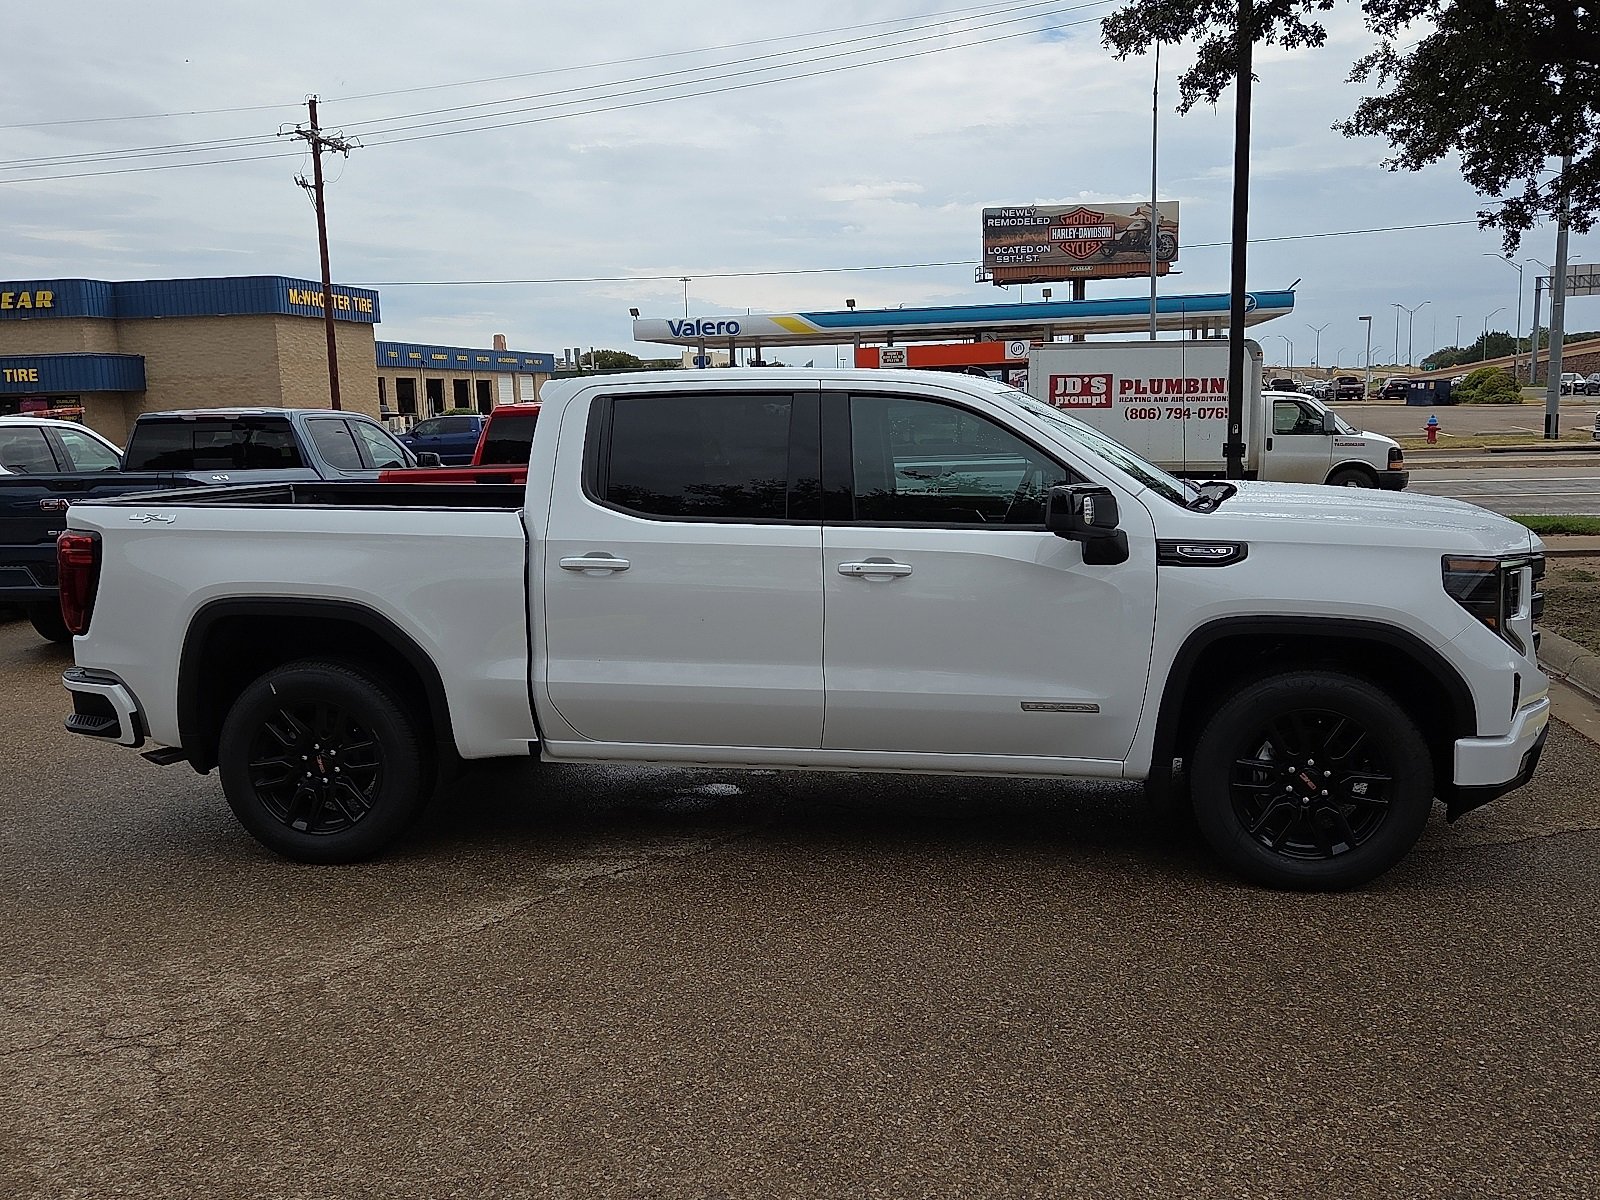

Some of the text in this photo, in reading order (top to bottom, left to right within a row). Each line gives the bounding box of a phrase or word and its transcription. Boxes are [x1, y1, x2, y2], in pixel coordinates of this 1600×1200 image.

[1001, 208, 1036, 217] NEWLY
[1066, 212, 1098, 225] MOTOR
[987, 217, 1050, 226] REMODELED
[1051, 226, 1112, 240] HARLEY-DAVIDSON
[988, 245, 1051, 255] LOCATED ON
[1065, 241, 1097, 256] CYCLES
[1025, 254, 1041, 262] ST.
[288, 288, 373, 313] McWHOTER TIRE
[667, 318, 740, 337] Valero
[3, 368, 39, 382] TIRE
[1119, 377, 1229, 395] PLUMBIN
[1054, 394, 1107, 407] prompt
[1124, 406, 1162, 420] (806)
